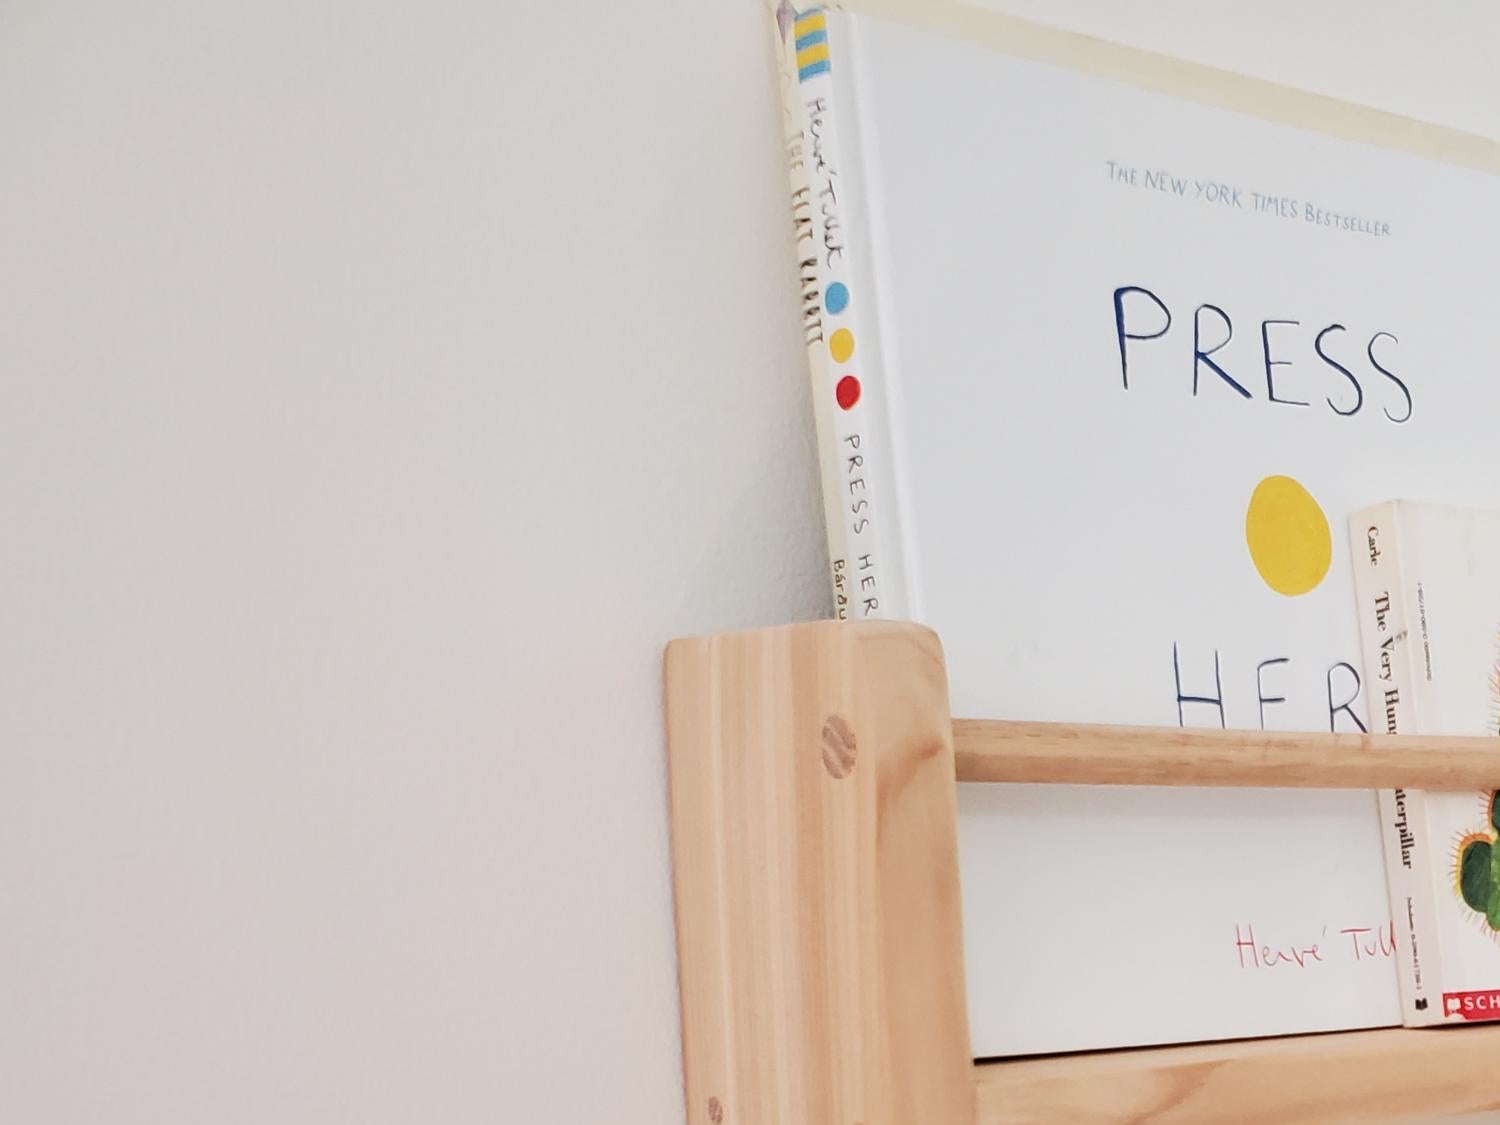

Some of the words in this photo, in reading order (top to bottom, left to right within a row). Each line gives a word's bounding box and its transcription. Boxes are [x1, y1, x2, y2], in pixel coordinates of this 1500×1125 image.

[1105, 160, 1137, 185] THE
[1144, 169, 1187, 197] NEW
[1194, 180, 1242, 209] YORK
[1251, 192, 1298, 218] TIMES
[1304, 203, 1390, 237] BESTSELLER
[1113, 285, 1413, 424] PRESS
[844, 434, 869, 535] PRESS
[858, 553, 879, 617] HER
[1367, 526, 1381, 568] Carle
[1374, 591, 1390, 632] The
[1379, 637, 1395, 682] Very
[1384, 688, 1399, 735] Hun
[1340, 919, 1397, 961] Tull
